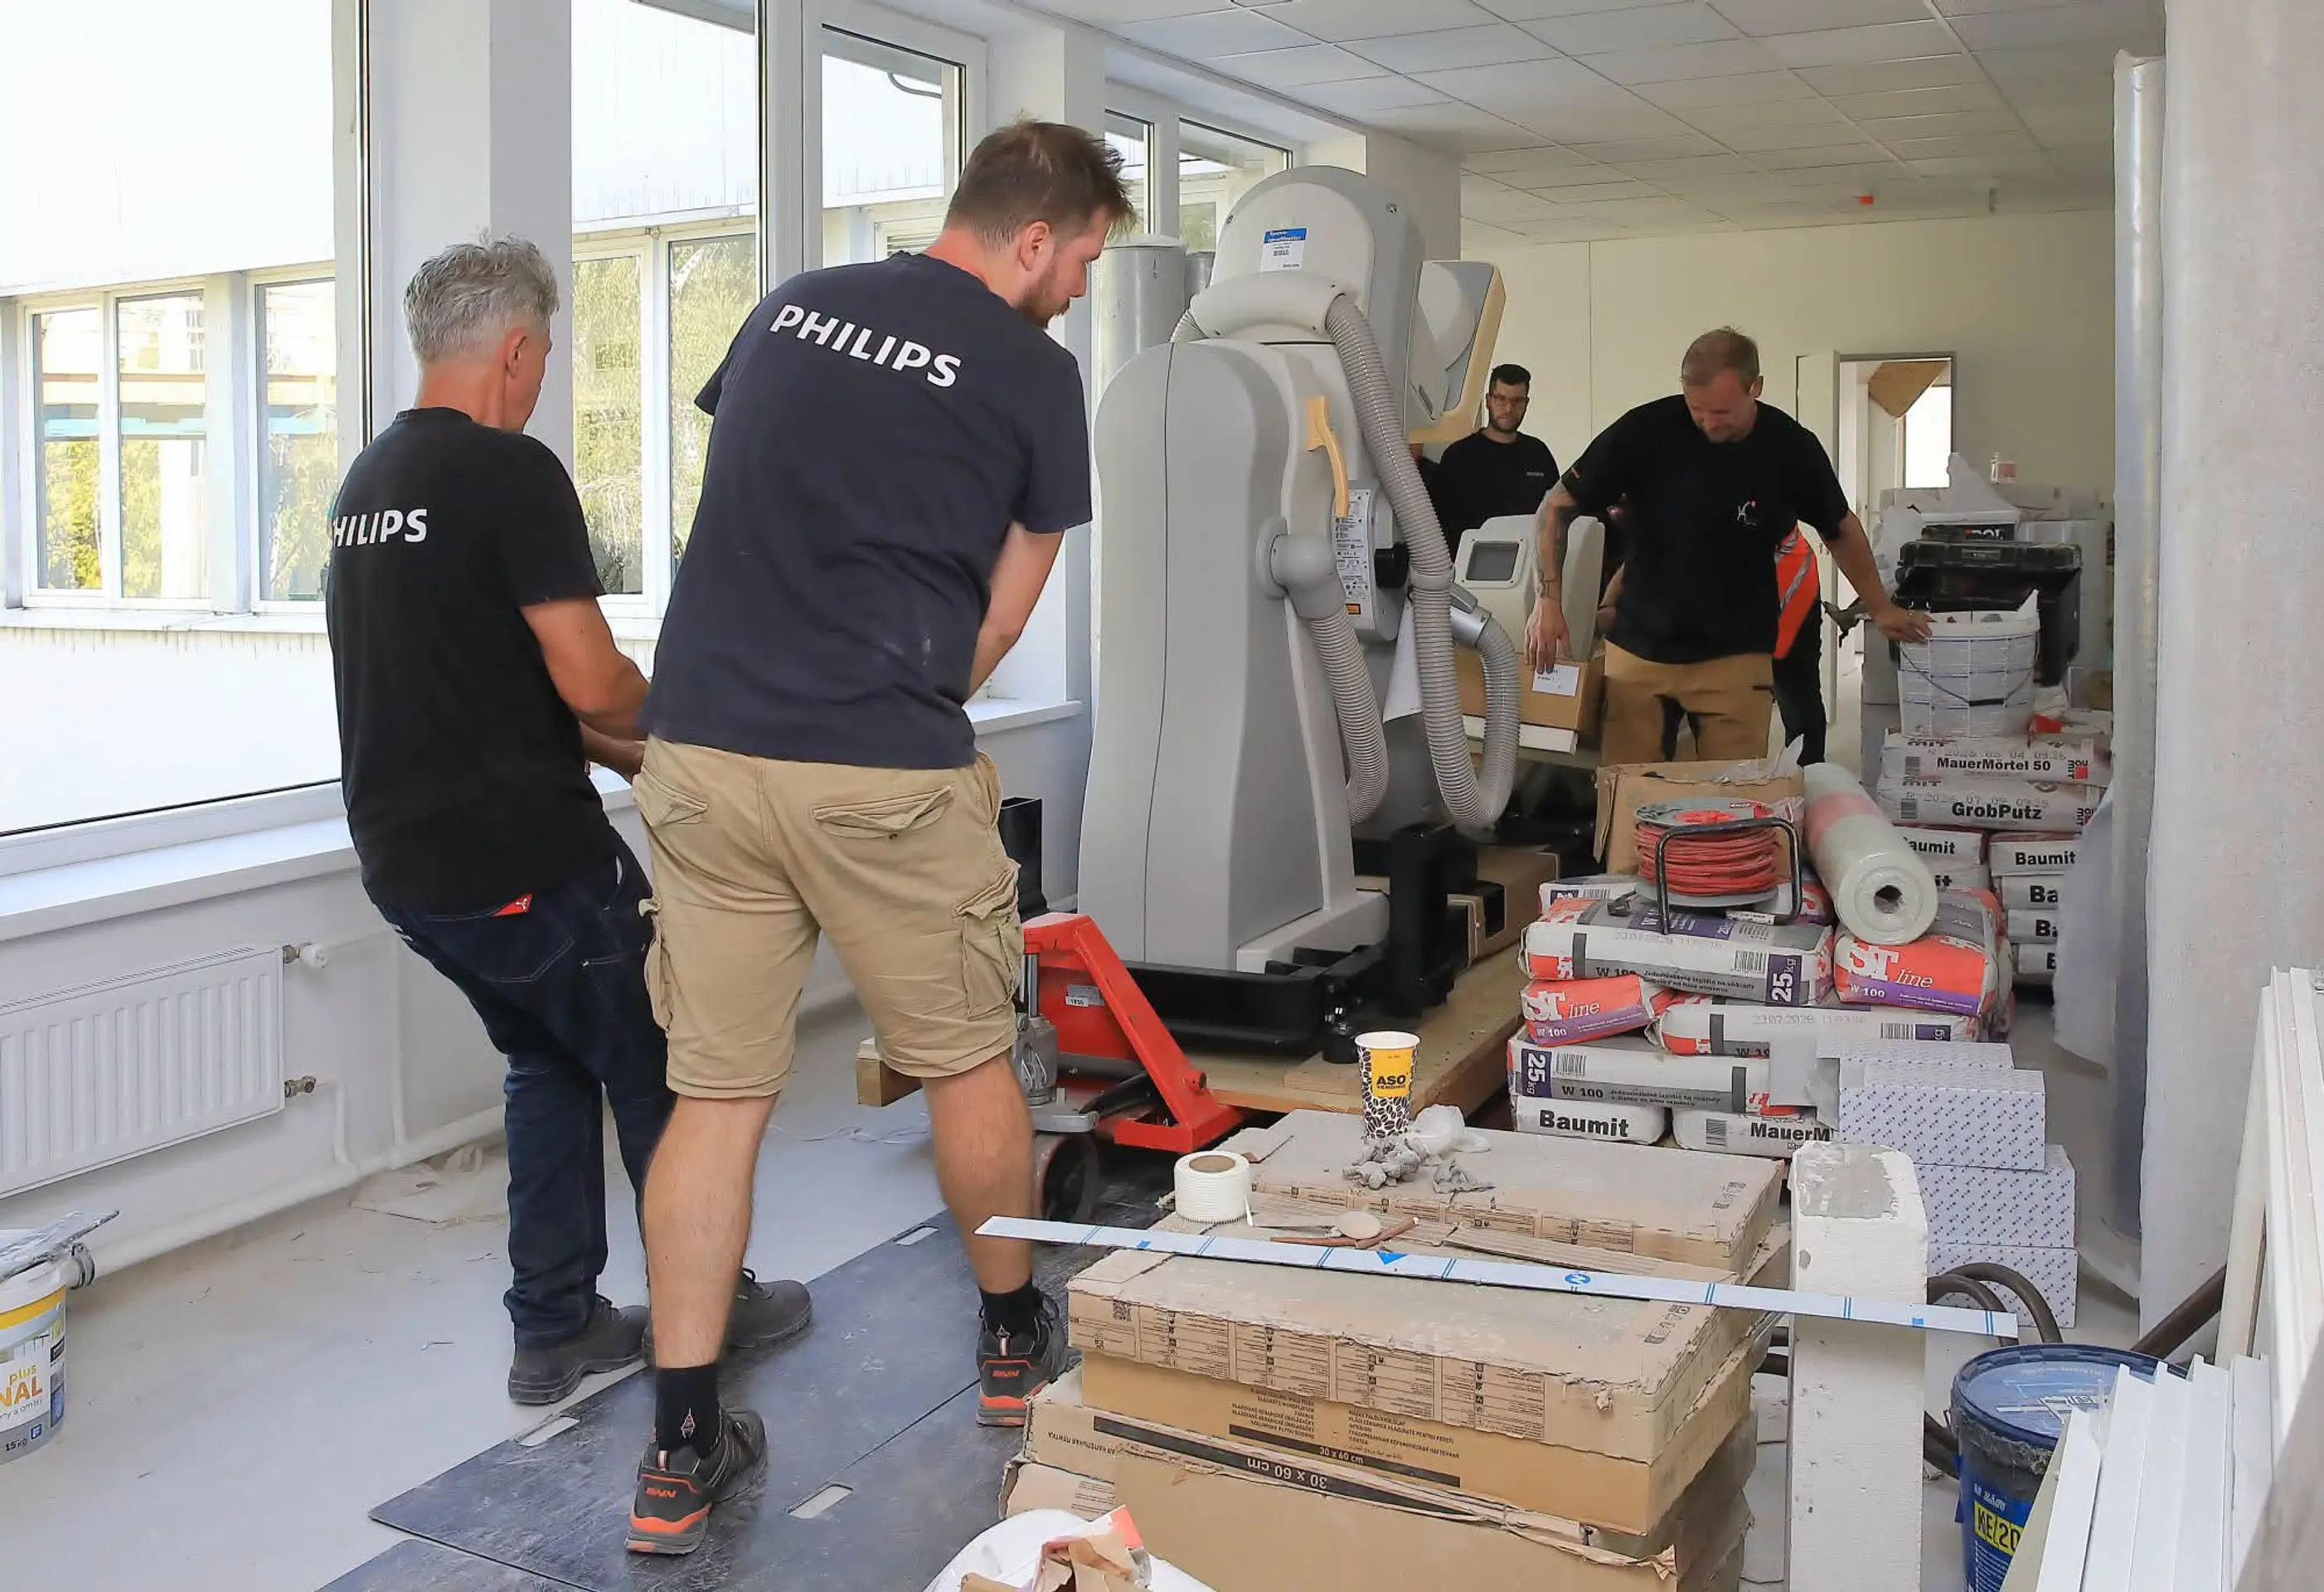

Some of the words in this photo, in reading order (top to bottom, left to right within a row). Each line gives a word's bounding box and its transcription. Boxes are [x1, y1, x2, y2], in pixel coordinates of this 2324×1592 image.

[770, 303, 964, 388] PHILIPS
[334, 508, 428, 547] HILIPS
[1937, 757, 2028, 771] MauerMörtel
[2033, 760, 2050, 770] 50
[1953, 802, 2042, 820] GrobPutz
[1904, 837, 1956, 855] aumit
[2015, 851, 2076, 866] Baumit
[1596, 967, 1610, 977] W
[1894, 968, 1934, 988] line
[1850, 983, 1861, 993] W
[1863, 987, 1885, 997] 100
[1569, 1002, 1600, 1020] line
[1536, 1027, 1549, 1036] W
[1549, 1028, 1567, 1037] 100
[1376, 1075, 1406, 1085] ASO
[1562, 1085, 1578, 1097] W
[1580, 1088, 1604, 1099] 100
[1540, 1109, 1628, 1138] Baumit
[1750, 1122, 1833, 1143] MauerM
[9, 1365, 37, 1386] plus
[1320, 1446, 1330, 1456] 30
[1338, 1451, 1350, 1462] 60
[1351, 1455, 1364, 1464] cm
[1247, 1457, 1270, 1472] cm
[1274, 1463, 1293, 1480] 60
[1297, 1470, 1305, 1482] x
[1310, 1473, 1327, 1489] 30
